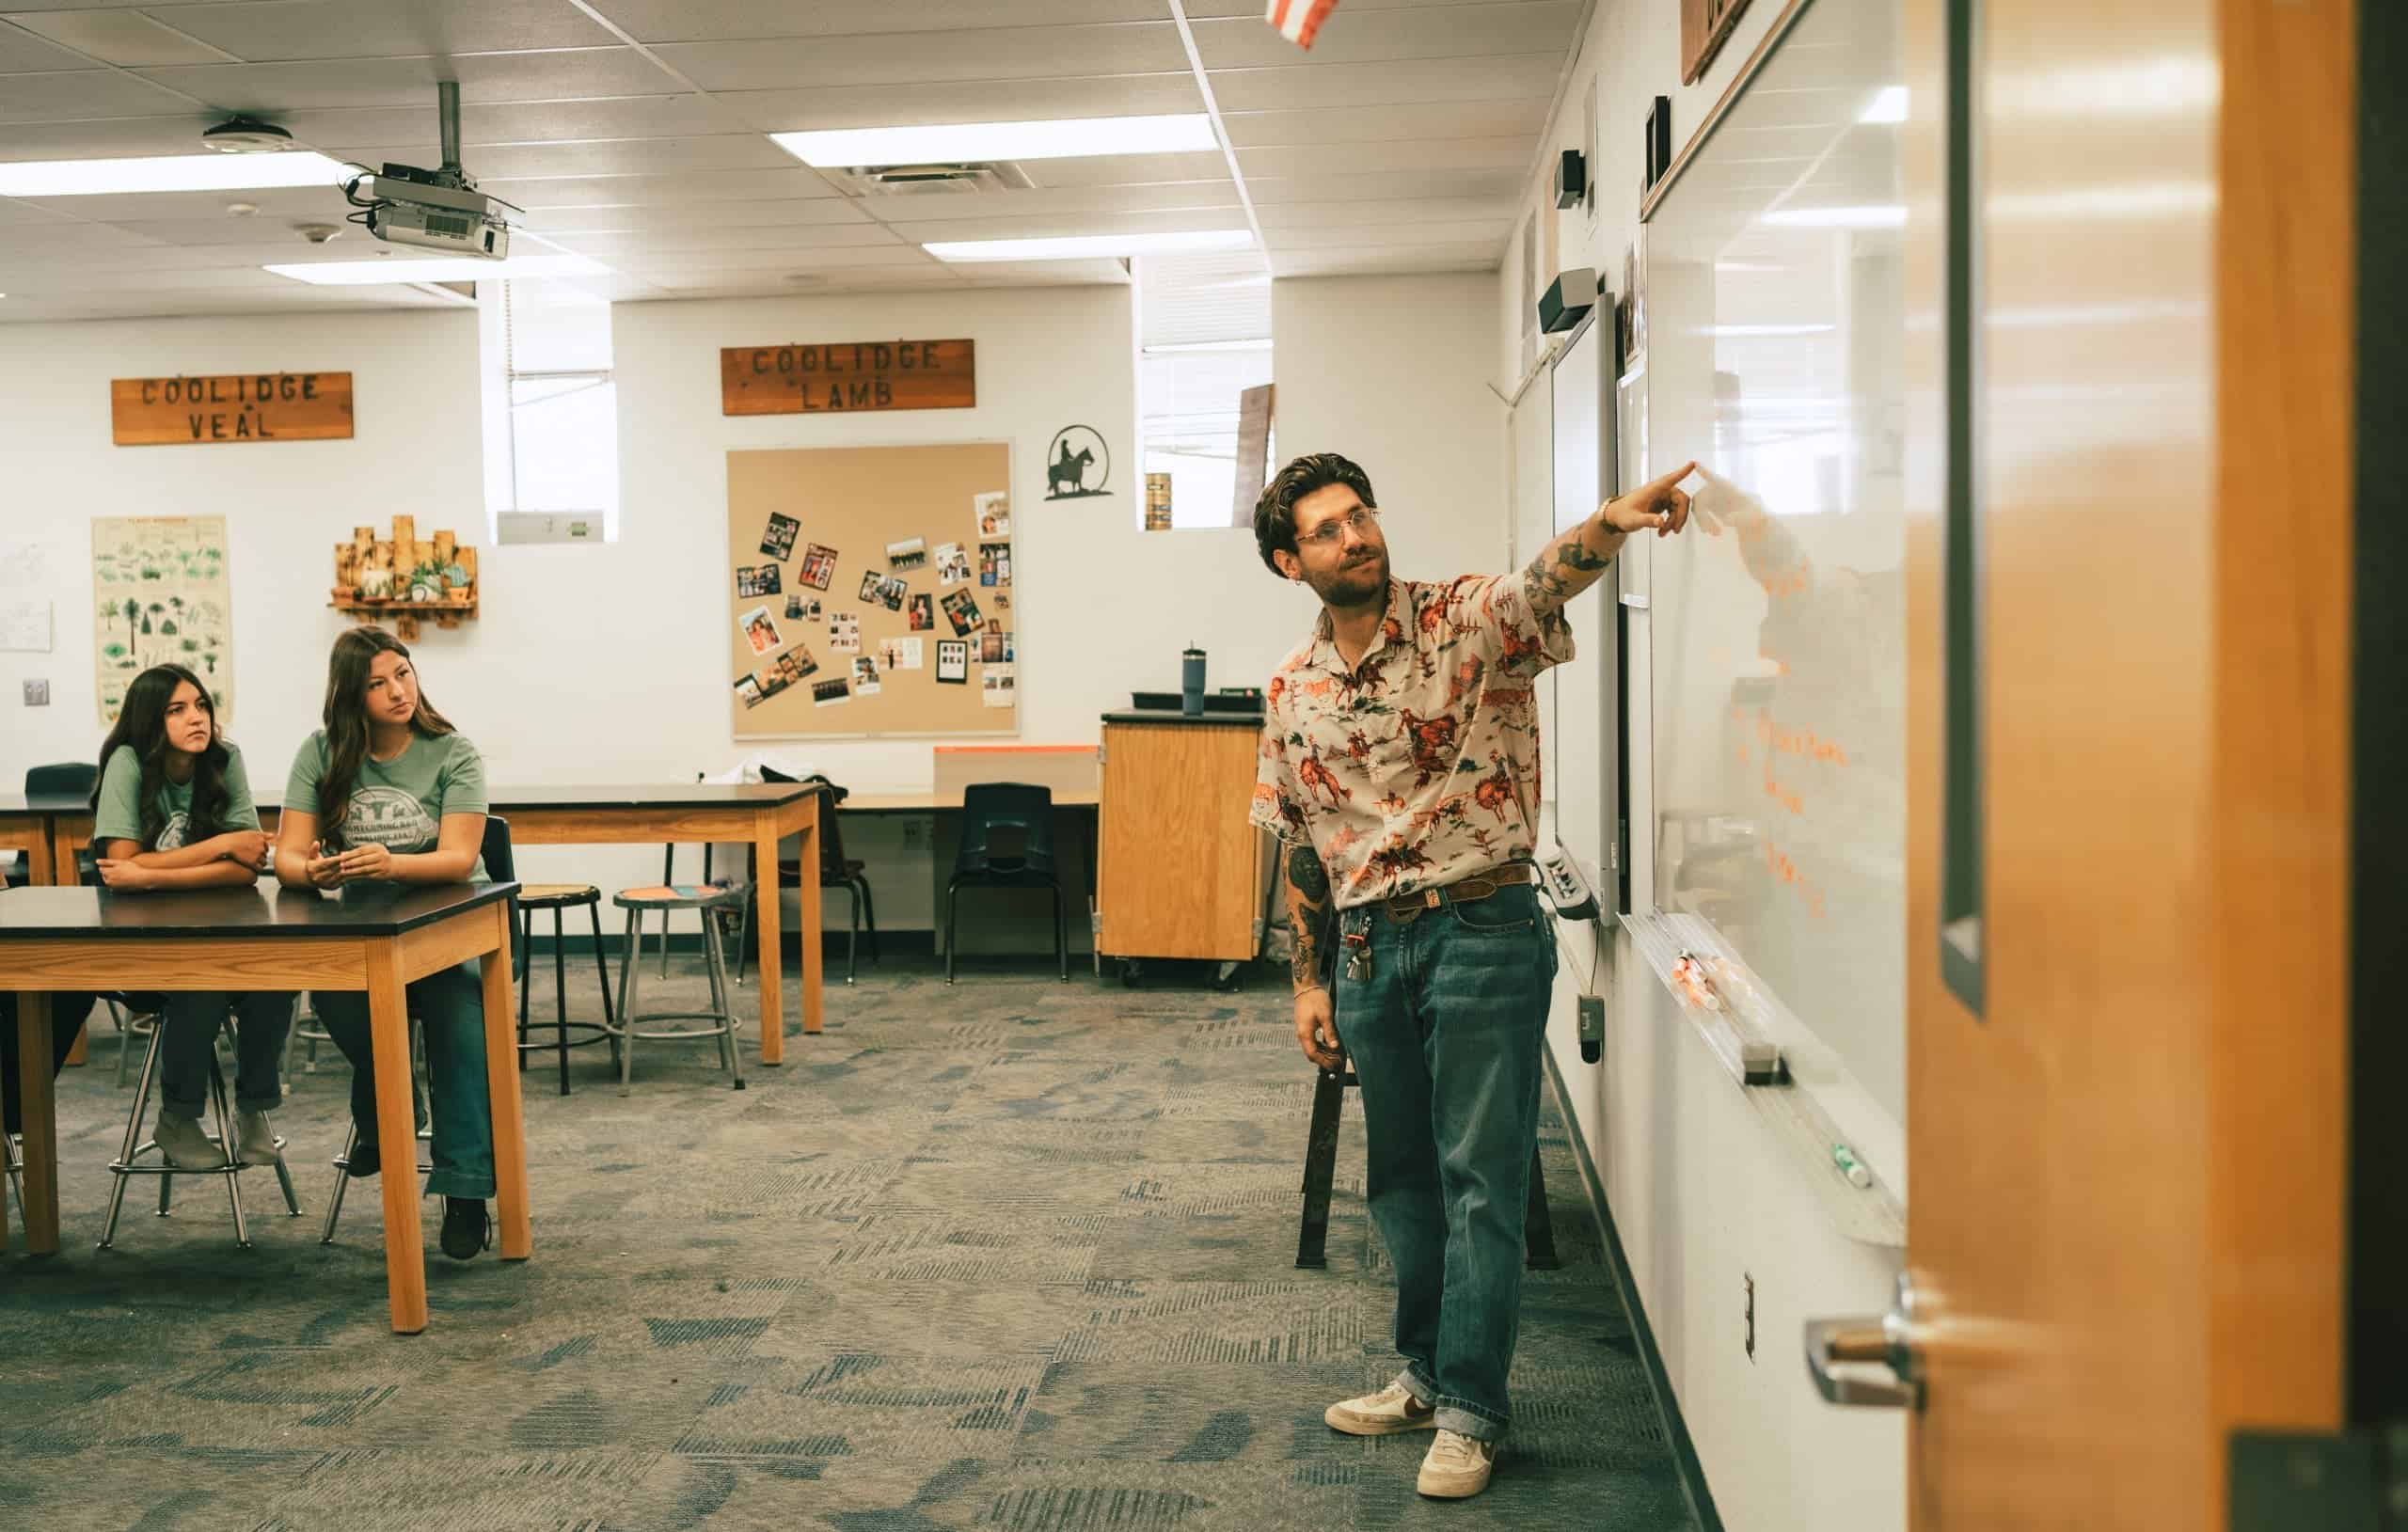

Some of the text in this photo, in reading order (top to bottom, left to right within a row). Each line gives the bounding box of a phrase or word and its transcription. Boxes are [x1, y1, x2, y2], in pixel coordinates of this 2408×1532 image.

[753, 343, 941, 374] COOLIDGE
[141, 375, 318, 404] COOLIDGE
[801, 382, 893, 409] LAMB
[189, 413, 273, 439] VEAL
